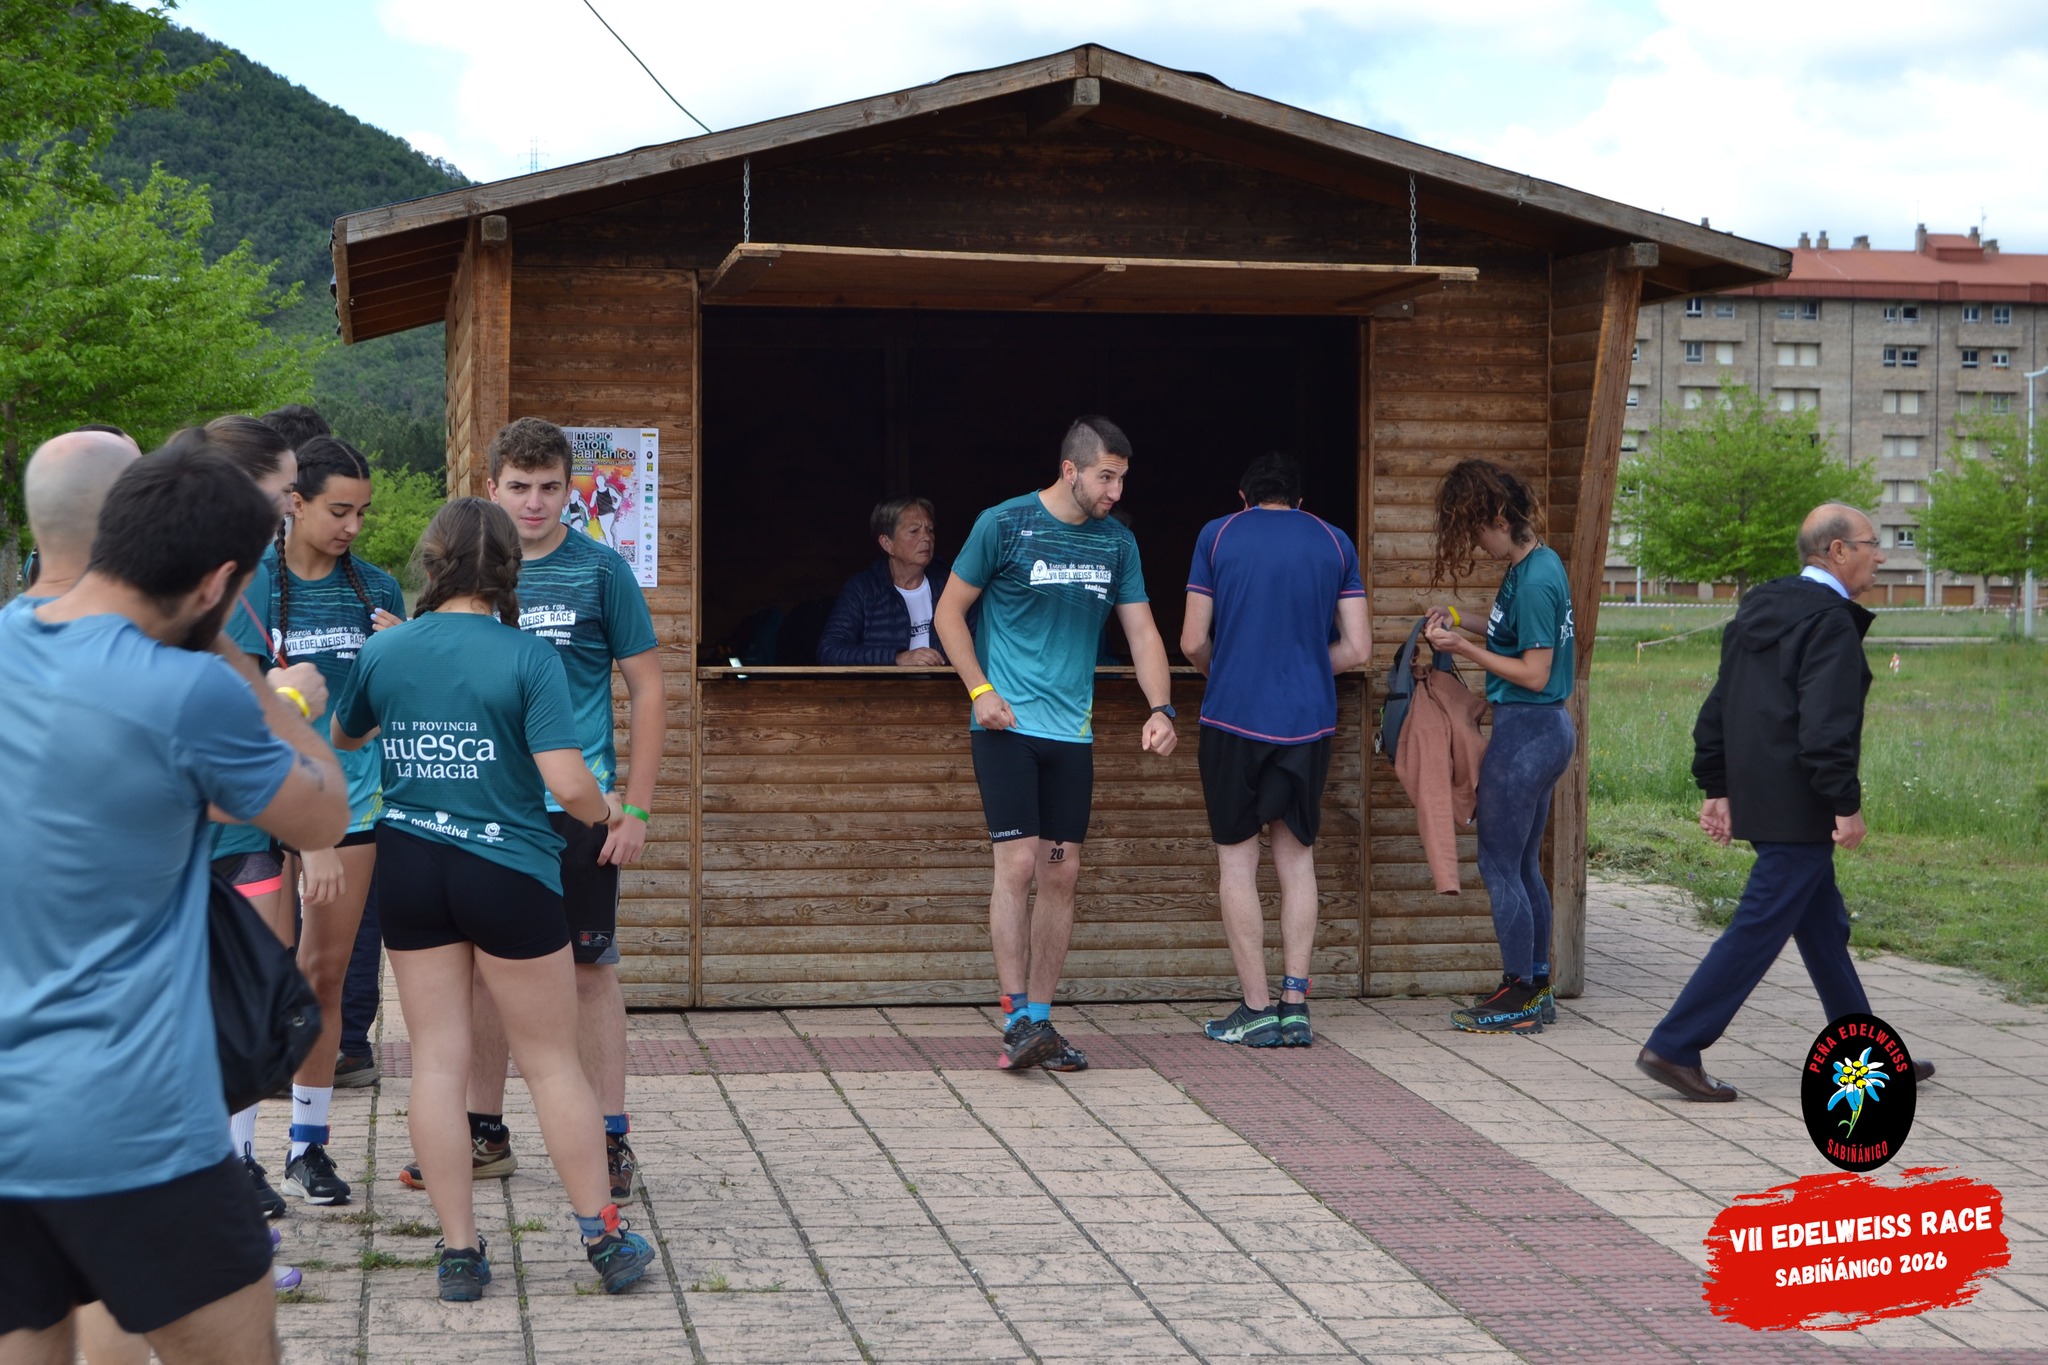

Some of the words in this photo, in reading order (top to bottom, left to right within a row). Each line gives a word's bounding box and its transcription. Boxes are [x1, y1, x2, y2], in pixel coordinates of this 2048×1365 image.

[572, 441, 607, 450] RaTOn
[1058, 571, 1092, 580] EDELWEISS
[1095, 571, 1110, 581] RACE
[520, 614, 545, 627] WEISS
[550, 612, 572, 623] RACE
[315, 627, 323, 635] de
[286, 640, 297, 652] VII
[300, 636, 346, 650] EDELWEISS
[411, 818, 469, 839] nodoactiva
[1050, 848, 1064, 860] 20
